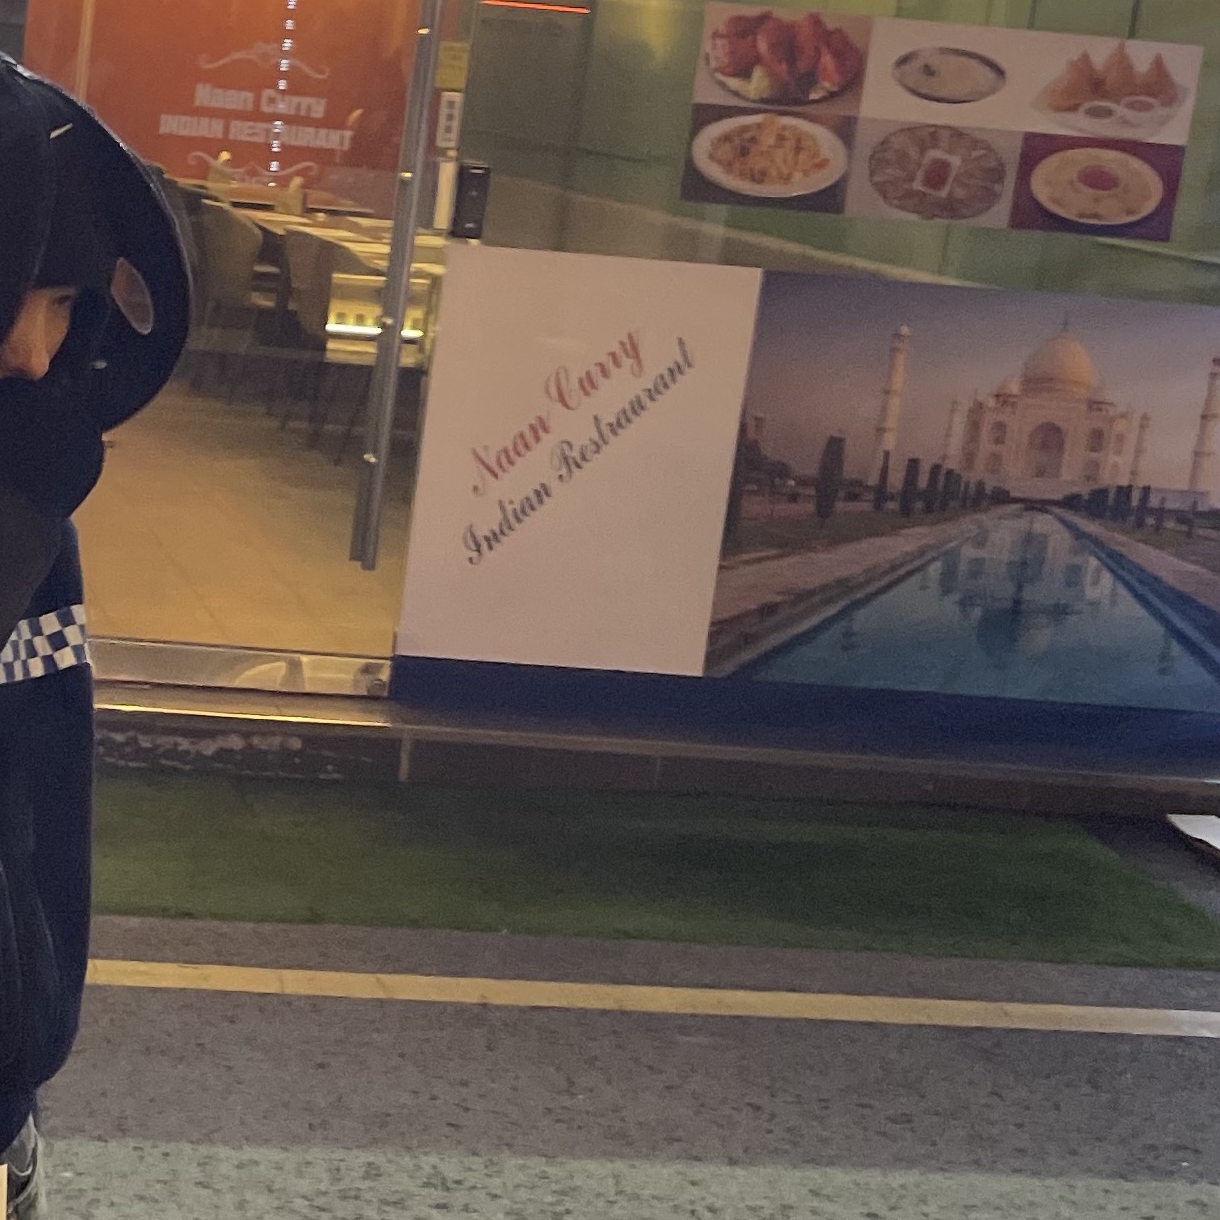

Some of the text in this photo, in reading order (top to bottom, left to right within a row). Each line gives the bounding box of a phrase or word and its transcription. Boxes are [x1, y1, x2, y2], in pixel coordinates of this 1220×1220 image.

[159, 113, 225, 139] INDIAN
[194, 82, 329, 119] Naan Curry
[472, 329, 643, 496] Naan Curry
[462, 482, 552, 566] Indian
